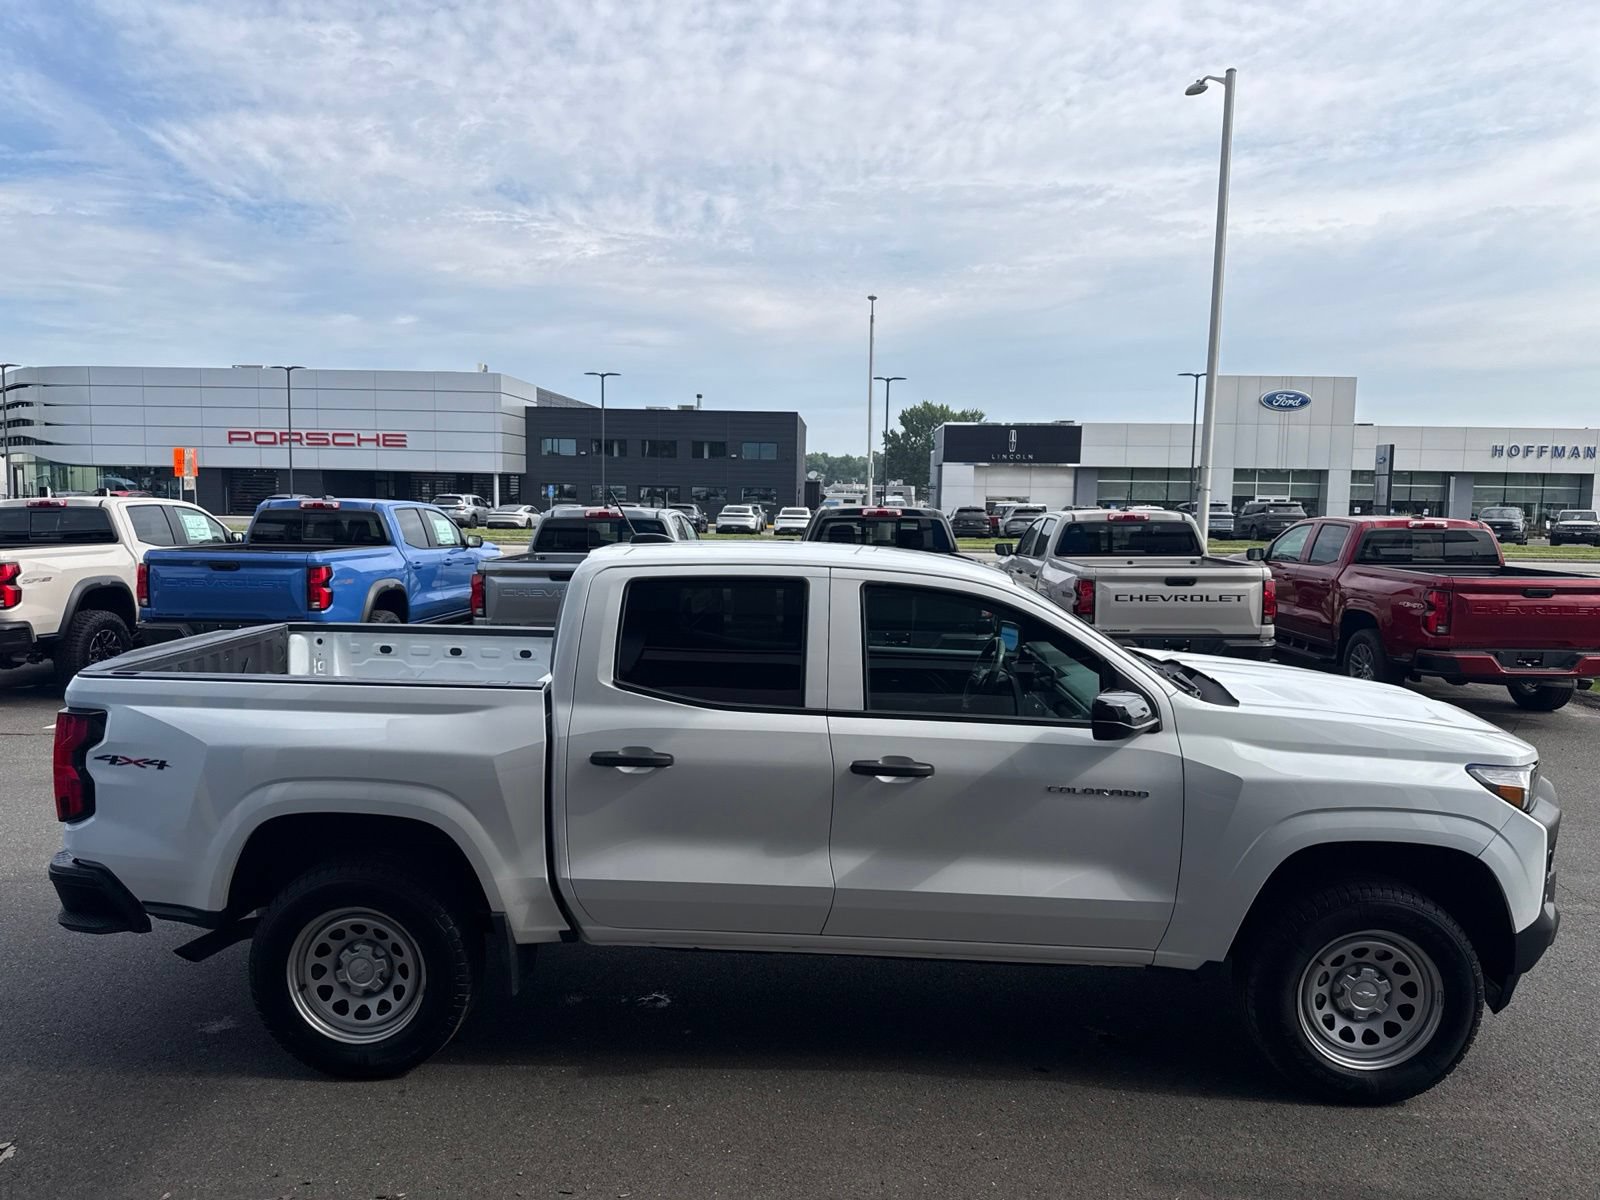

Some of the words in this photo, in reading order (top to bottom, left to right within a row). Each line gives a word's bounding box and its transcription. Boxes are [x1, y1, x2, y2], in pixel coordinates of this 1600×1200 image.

[1272, 393, 1303, 407] Ford
[228, 430, 408, 448] PORSCHE
[1491, 444, 1597, 459] HOFFMAN
[1115, 594, 1247, 603] CHEVROLET
[1047, 786, 1150, 799] COLORADO
